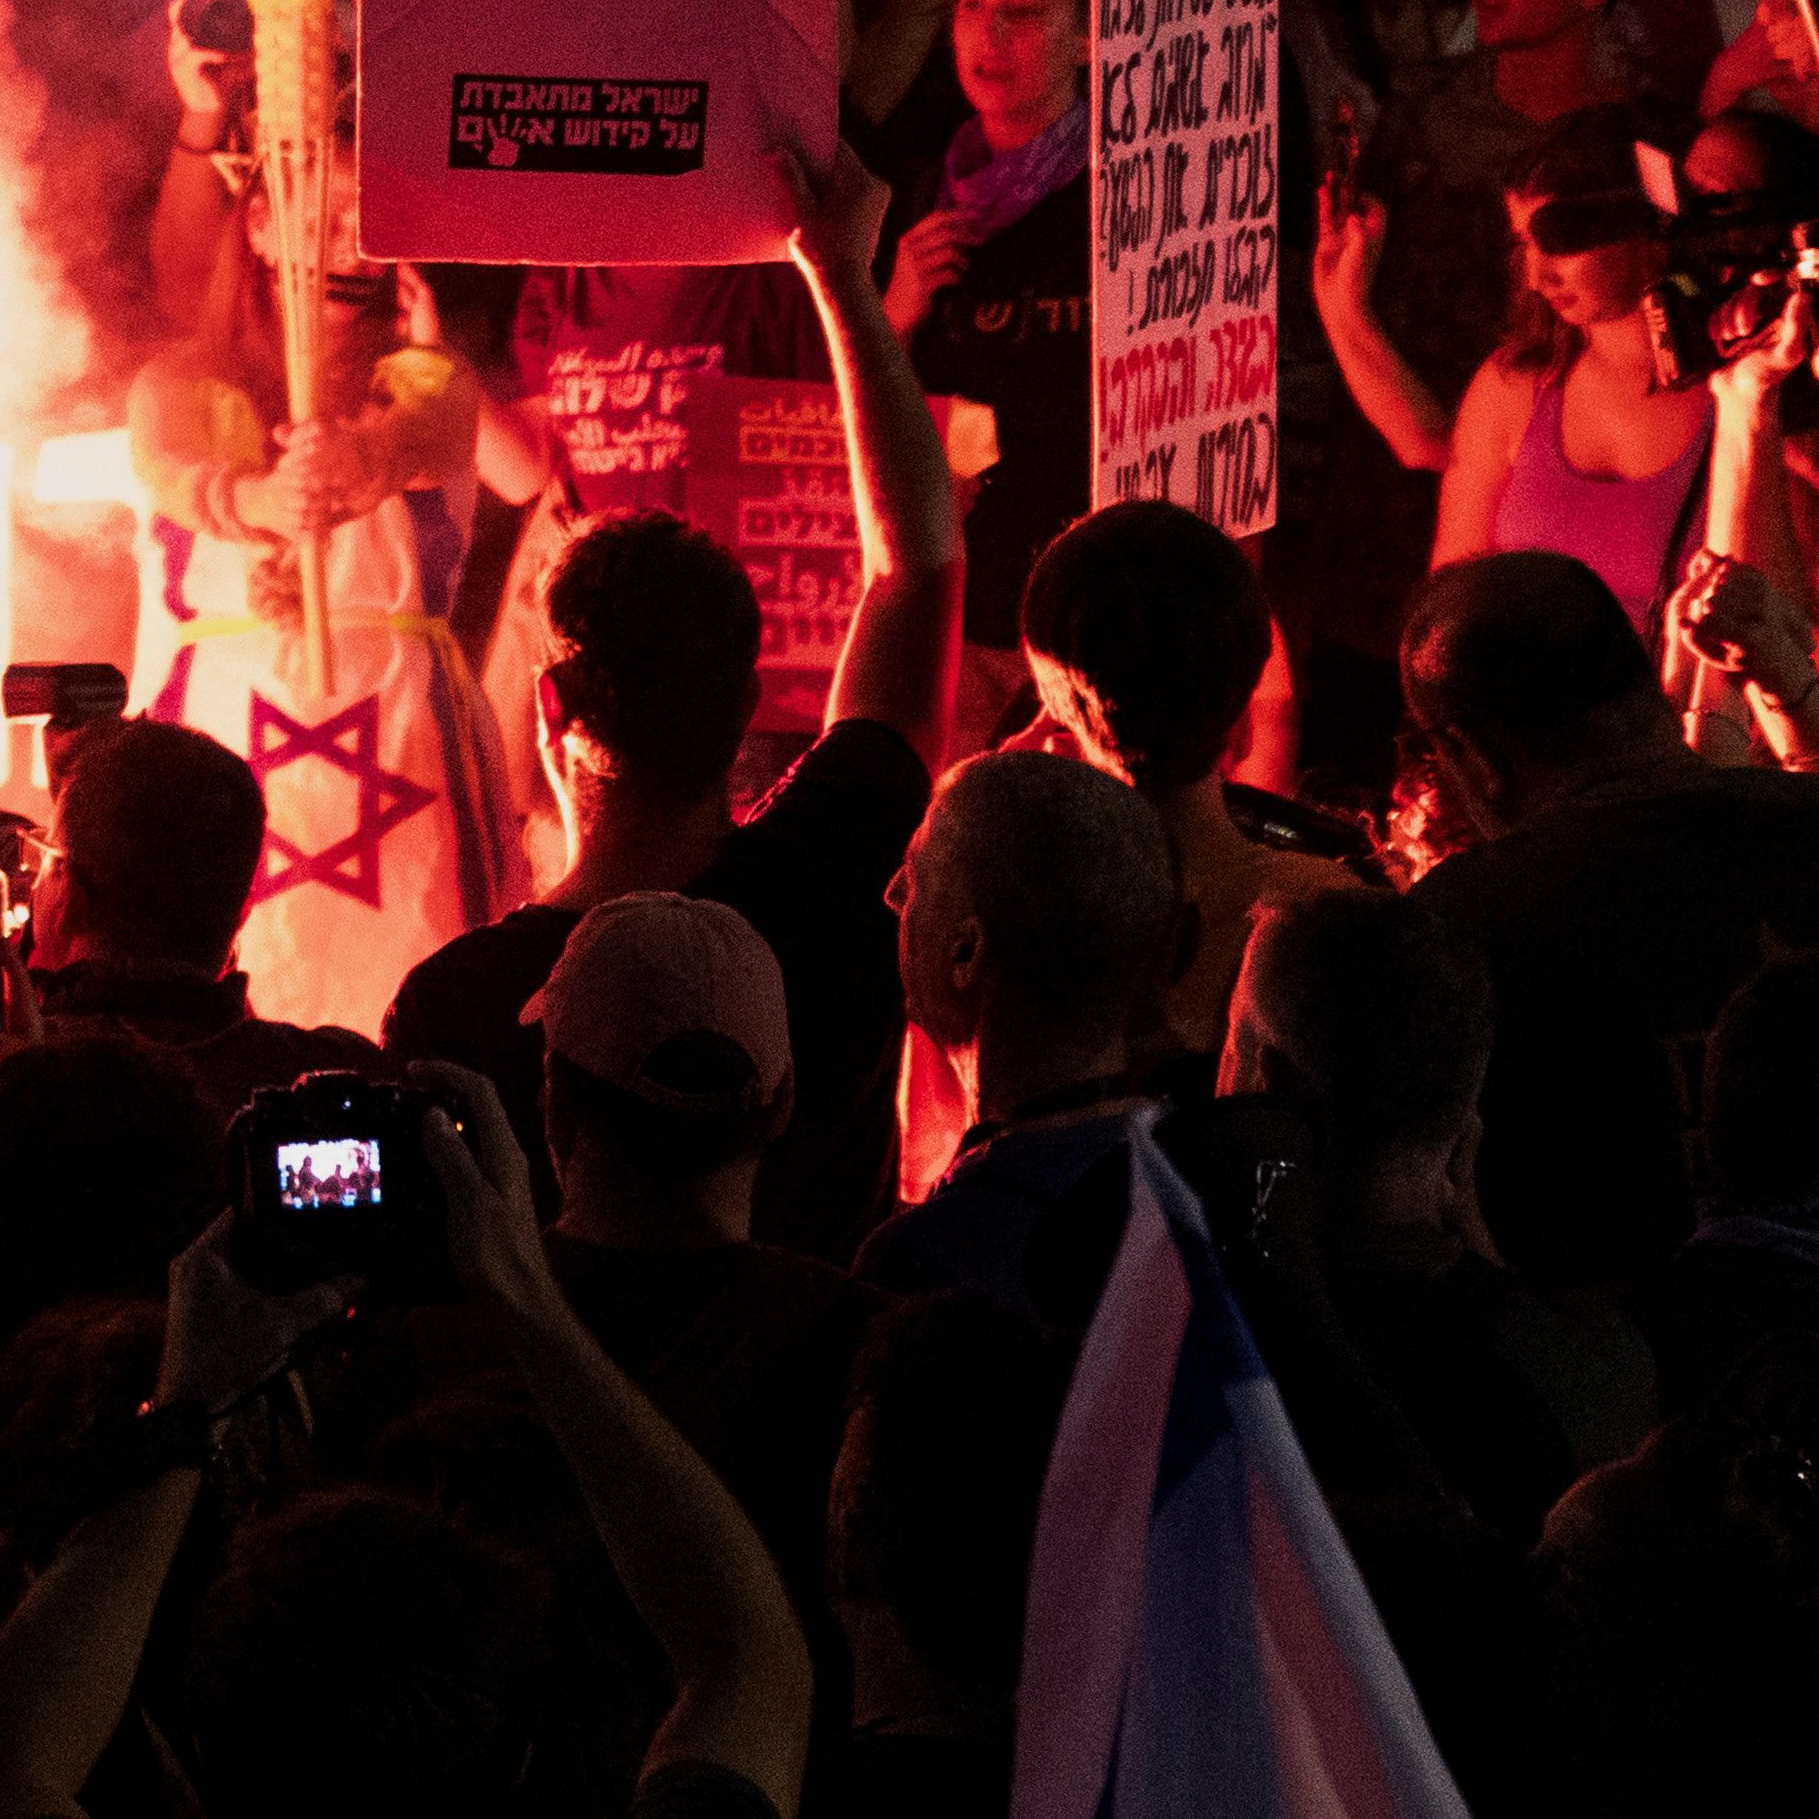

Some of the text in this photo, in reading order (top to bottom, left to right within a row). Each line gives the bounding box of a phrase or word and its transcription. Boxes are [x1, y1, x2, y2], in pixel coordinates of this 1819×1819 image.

[459, 79, 700, 118] ישראל מתאבדת
[564, 116, 651, 152] קידוש
[658, 118, 700, 152] על
[747, 502, 859, 541] צילים
